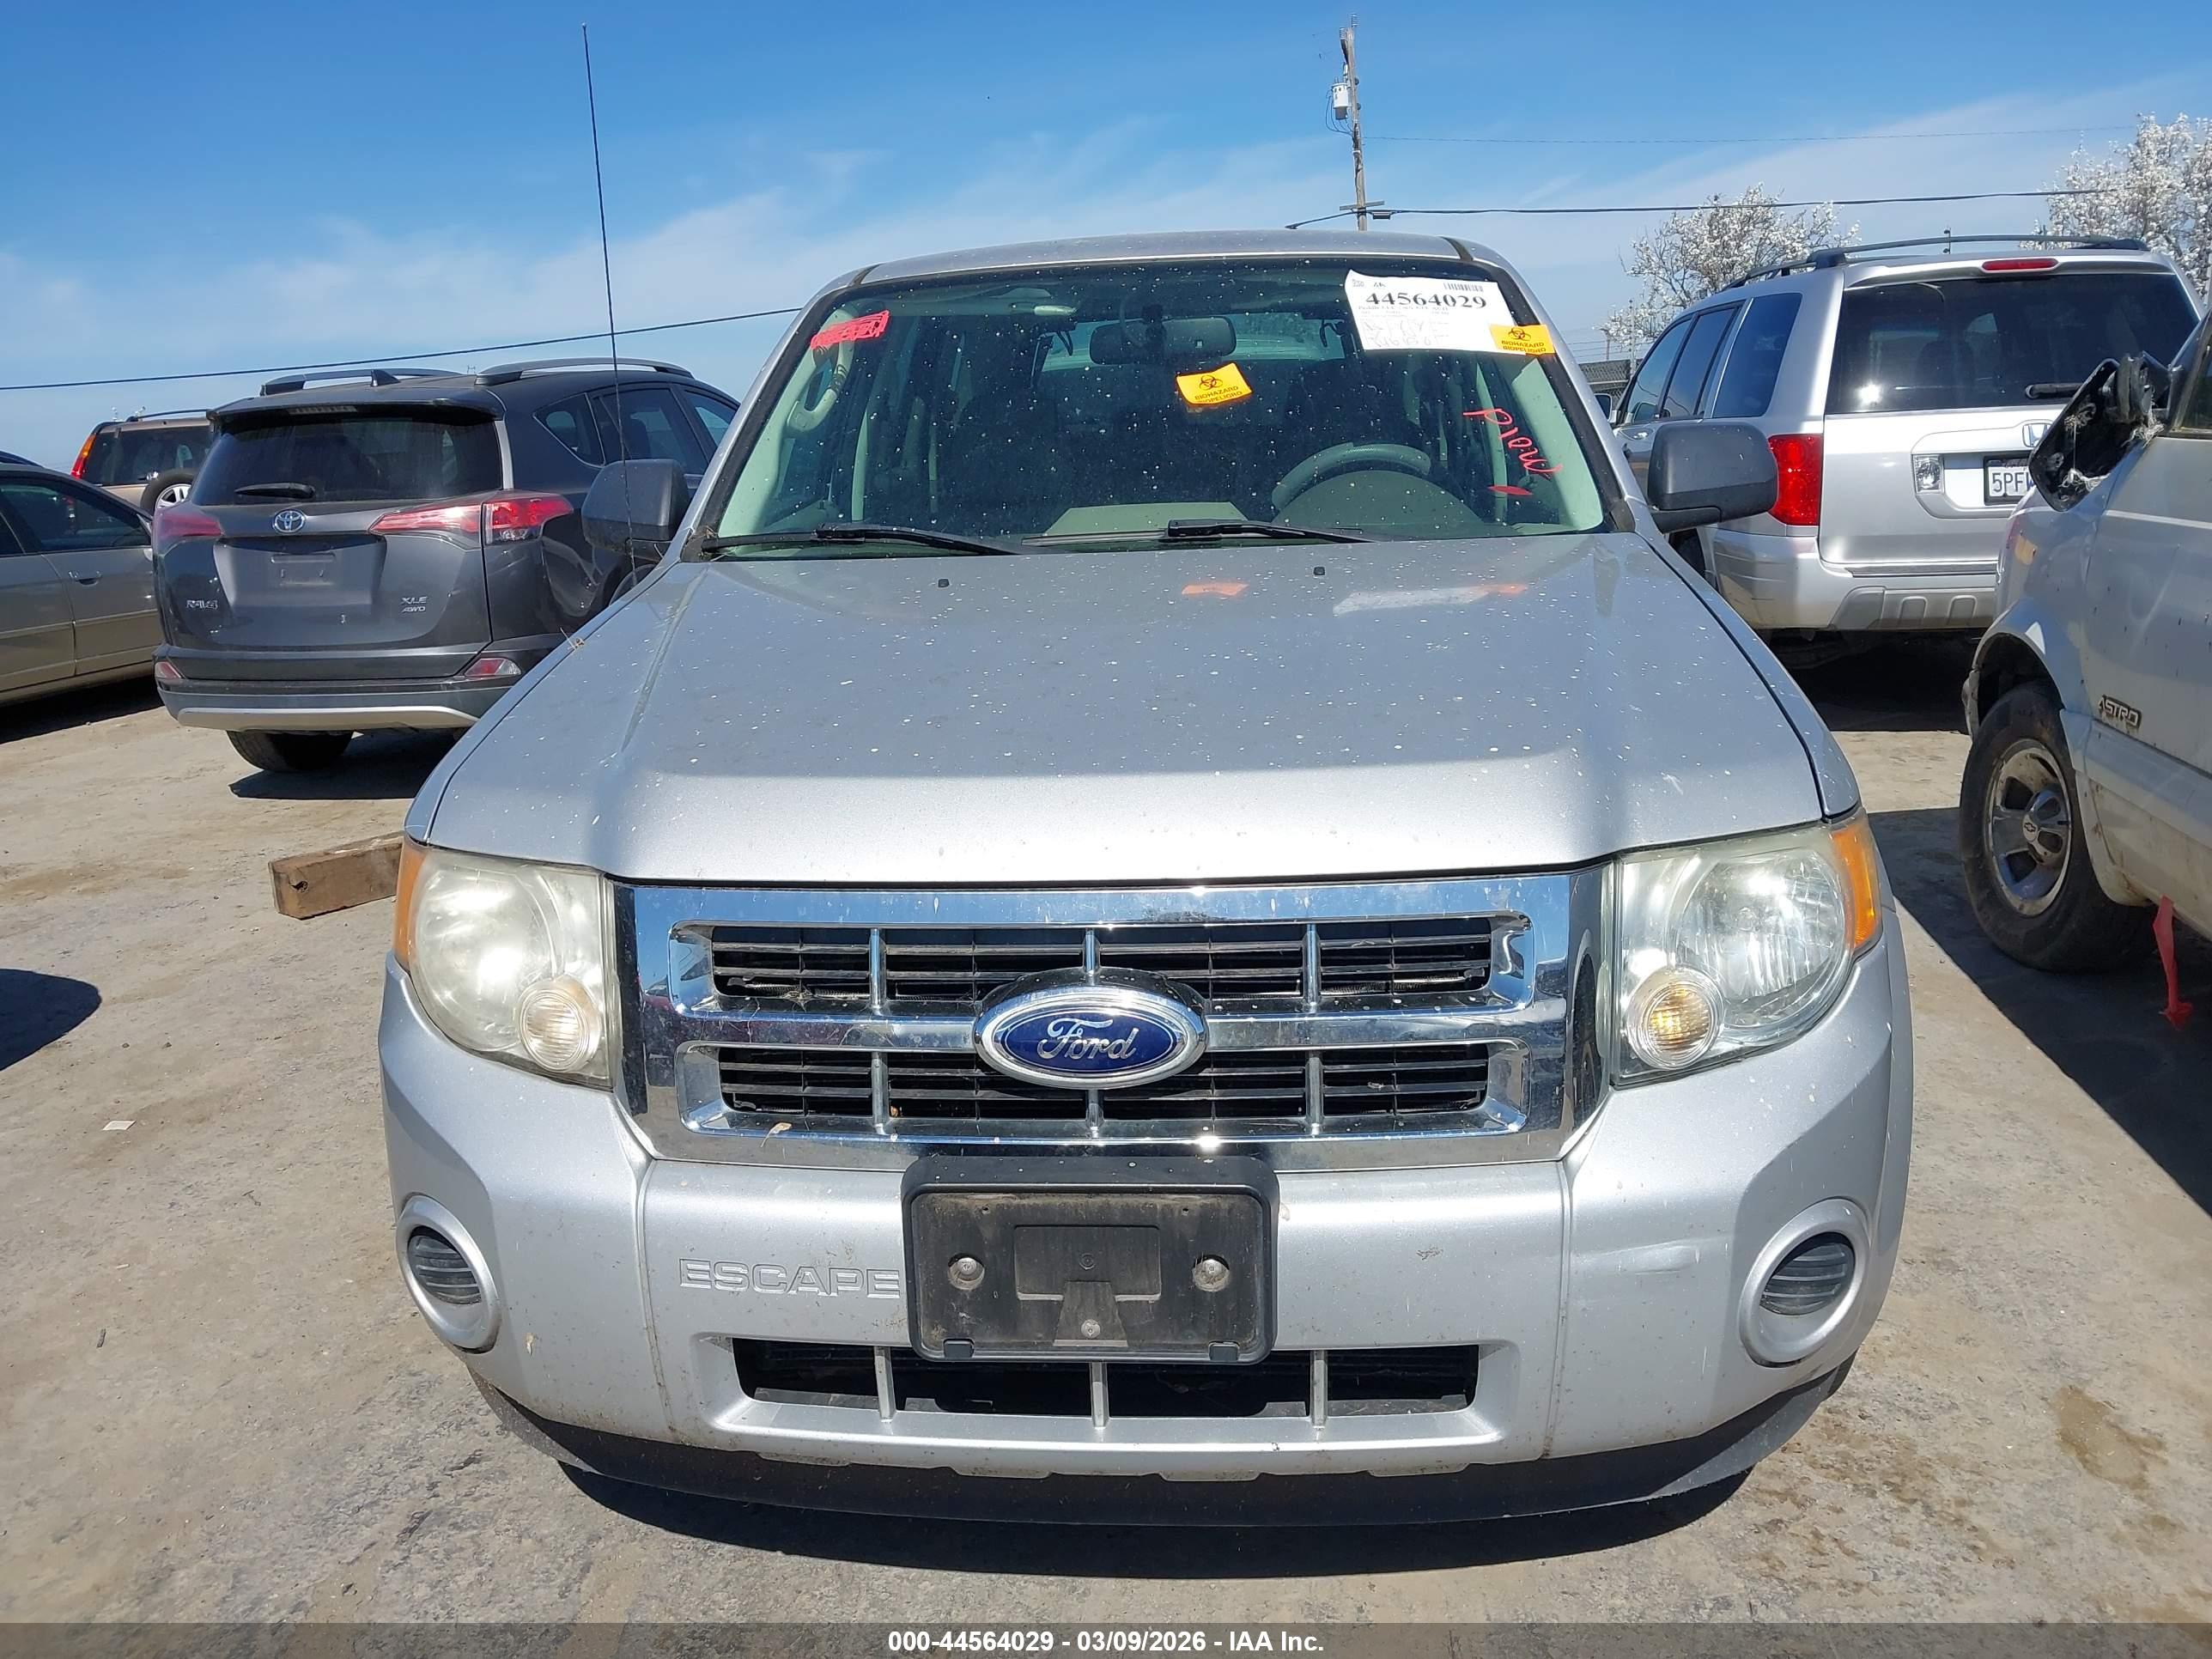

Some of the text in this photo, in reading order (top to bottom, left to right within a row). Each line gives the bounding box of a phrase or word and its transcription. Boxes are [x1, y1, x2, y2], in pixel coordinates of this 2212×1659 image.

[1365, 292, 1487, 308] 44564029
[1194, 386, 1239, 400] BIOHAZARD
[1199, 391, 1243, 403] OPELIGRO
[399, 596, 428, 605] XLE
[2098, 696, 2139, 726] ASTRO
[1037, 1017, 1139, 1060] Ford
[678, 1258, 901, 1299] ESCAPE
